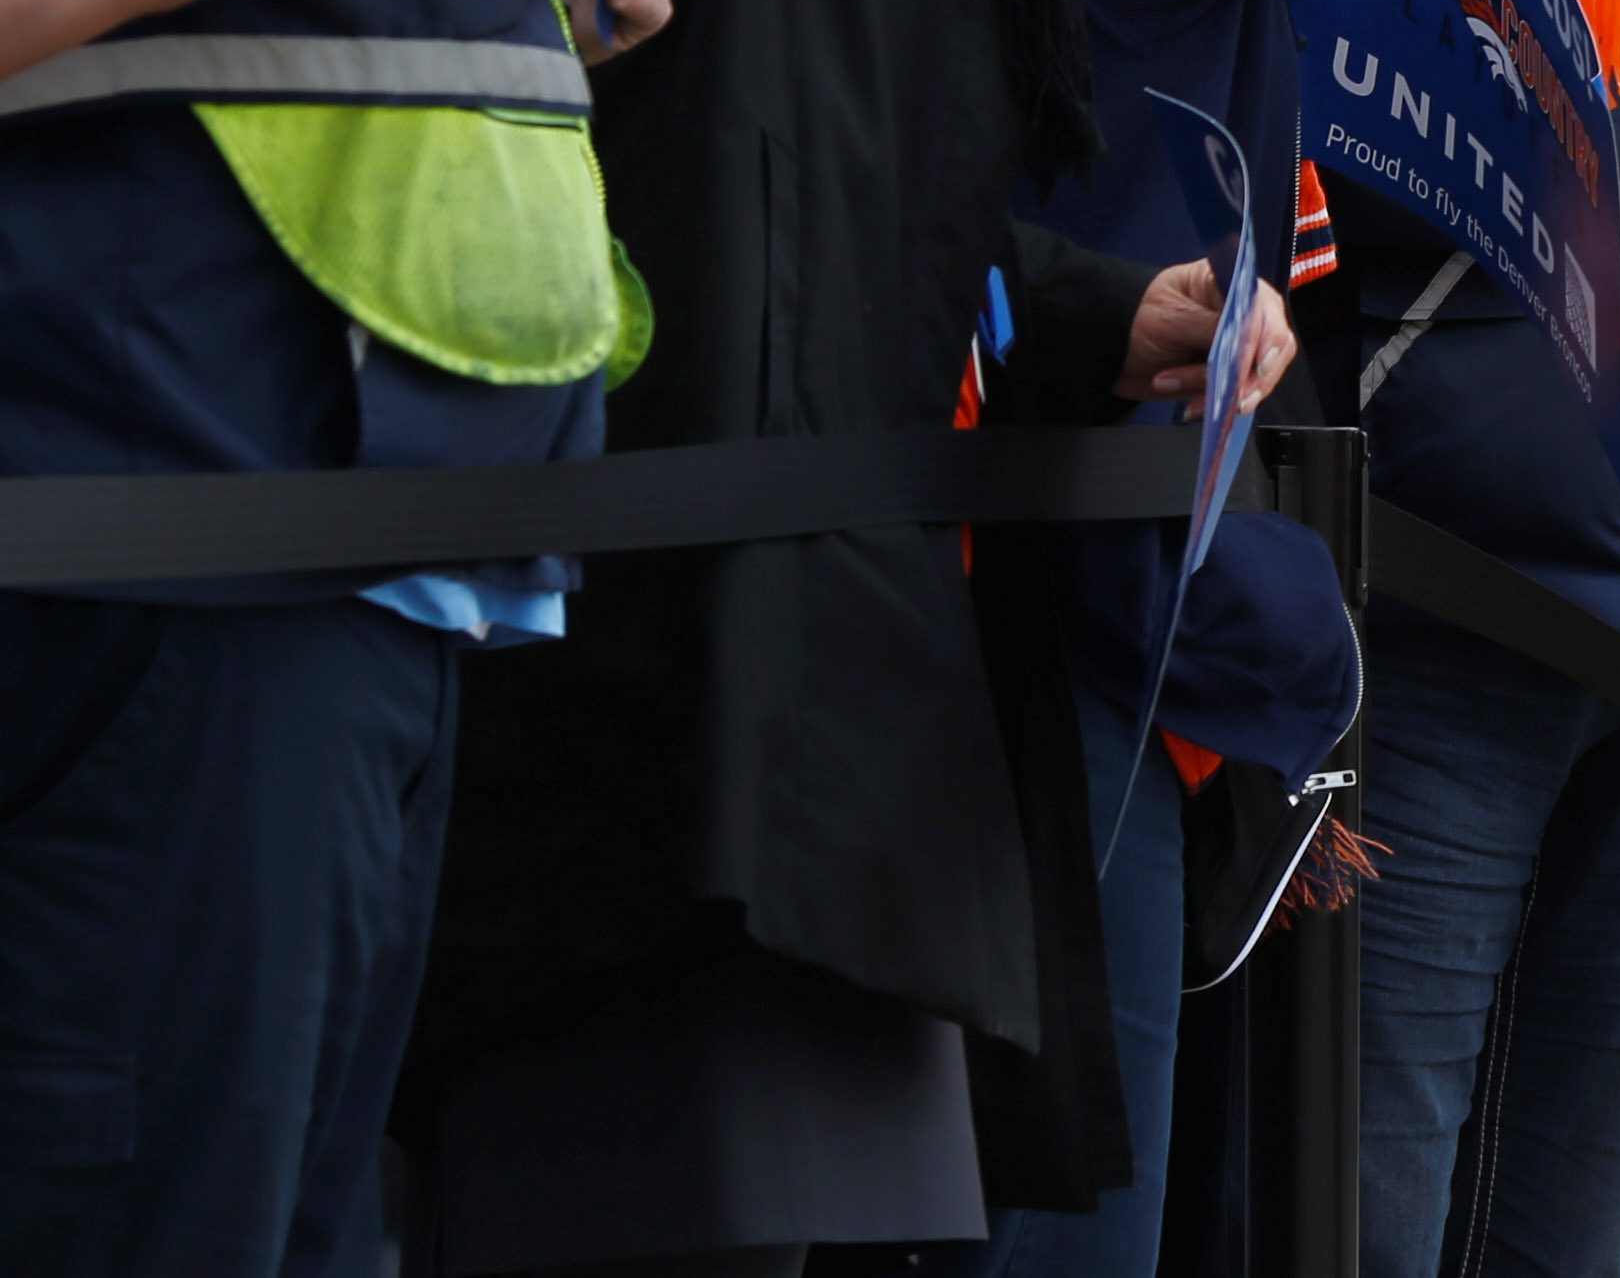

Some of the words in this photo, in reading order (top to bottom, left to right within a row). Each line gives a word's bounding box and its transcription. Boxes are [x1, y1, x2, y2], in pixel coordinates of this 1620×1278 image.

[1325, 122, 1401, 182] Proud
[1408, 167, 1430, 200] to
[1435, 187, 1462, 227] fly
[1466, 213, 1494, 258] the
[1498, 244, 1548, 321] Denver
[1549, 314, 1593, 404] Broncos
[1332, 36, 1556, 274] UNITED
